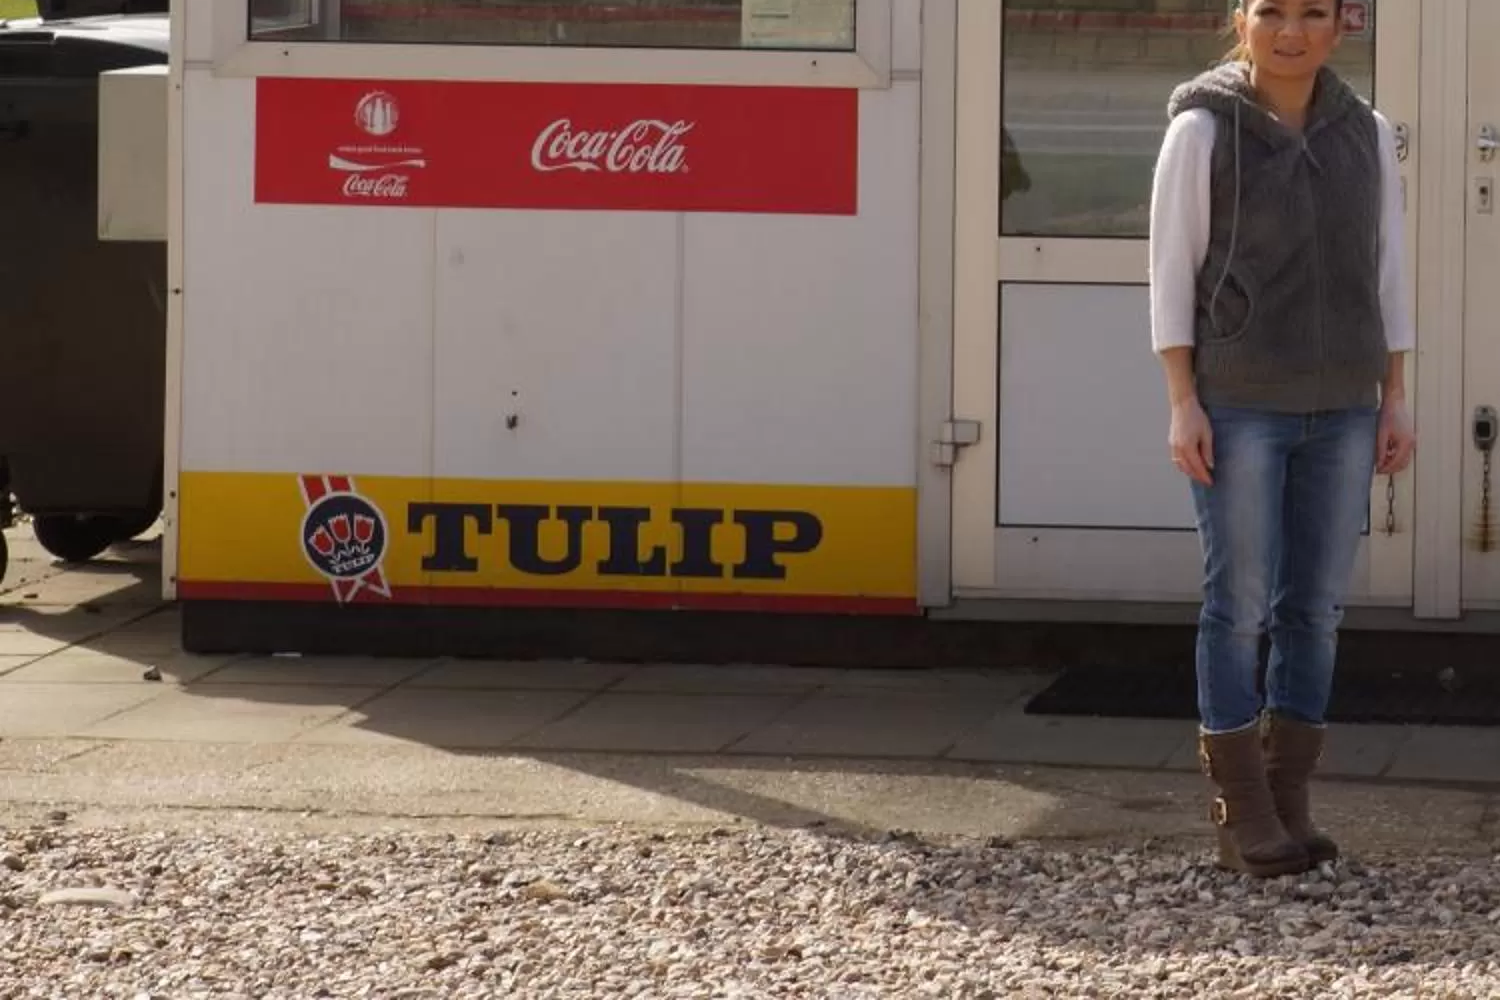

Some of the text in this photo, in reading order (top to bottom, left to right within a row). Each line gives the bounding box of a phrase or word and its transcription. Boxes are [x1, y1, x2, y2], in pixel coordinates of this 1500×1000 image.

[530, 118, 697, 174] Coca-Cola
[342, 173, 409, 198] Coca-Cola
[406, 501, 824, 581] TULIP
